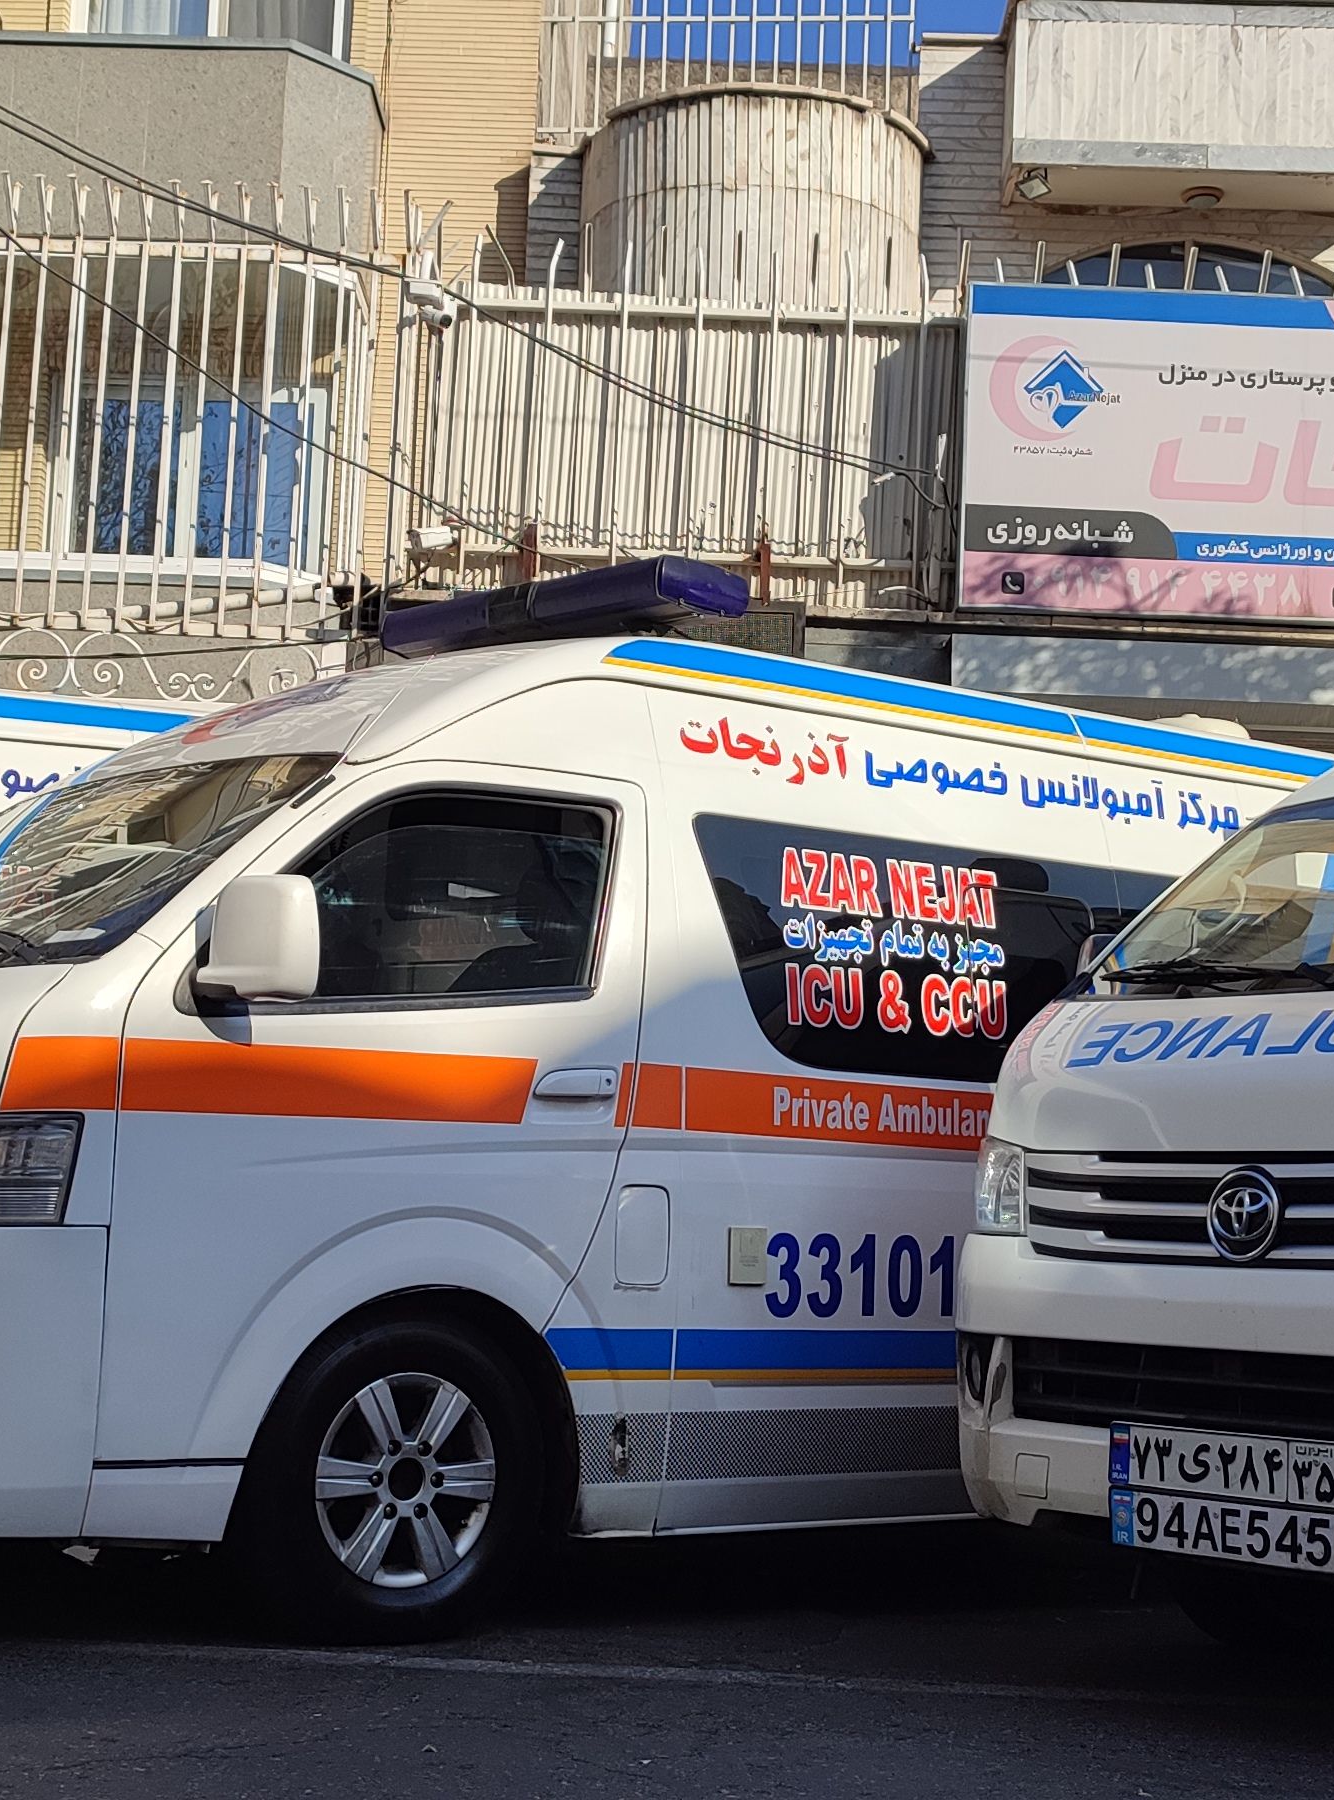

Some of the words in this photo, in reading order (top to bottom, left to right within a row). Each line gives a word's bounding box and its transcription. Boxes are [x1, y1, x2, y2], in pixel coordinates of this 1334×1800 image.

[1157, 363, 1208, 386] منزل
[1212, 369, 1236, 387] در
[1239, 368, 1327, 396] پرستاری
[1196, 539, 1250, 558] کشوری
[1249, 542, 1312, 560] اورژانس
[1313, 548, 1322, 562] و
[864, 749, 1009, 795] خصوصی
[1019, 773, 1165, 825] آمبولانس
[1176, 790, 1240, 834] مرکز
[781, 846, 884, 918] AZAR
[885, 858, 998, 929] NEJAT
[783, 911, 875, 964] تجهیزات
[879, 919, 924, 966] تمام
[927, 930, 950, 972] به
[784, 962, 865, 1030] ICU
[877, 969, 912, 1034] &
[920, 973, 1008, 1040] CCU
[772, 1086, 870, 1132] Private
[877, 1092, 990, 1138] Ambulan
[765, 1232, 955, 1319] 33101
[1295, 1445, 1333, 1459] ایران
[1117, 1530, 1129, 1543] IR
[1135, 1496, 1333, 1568] 94AE545
